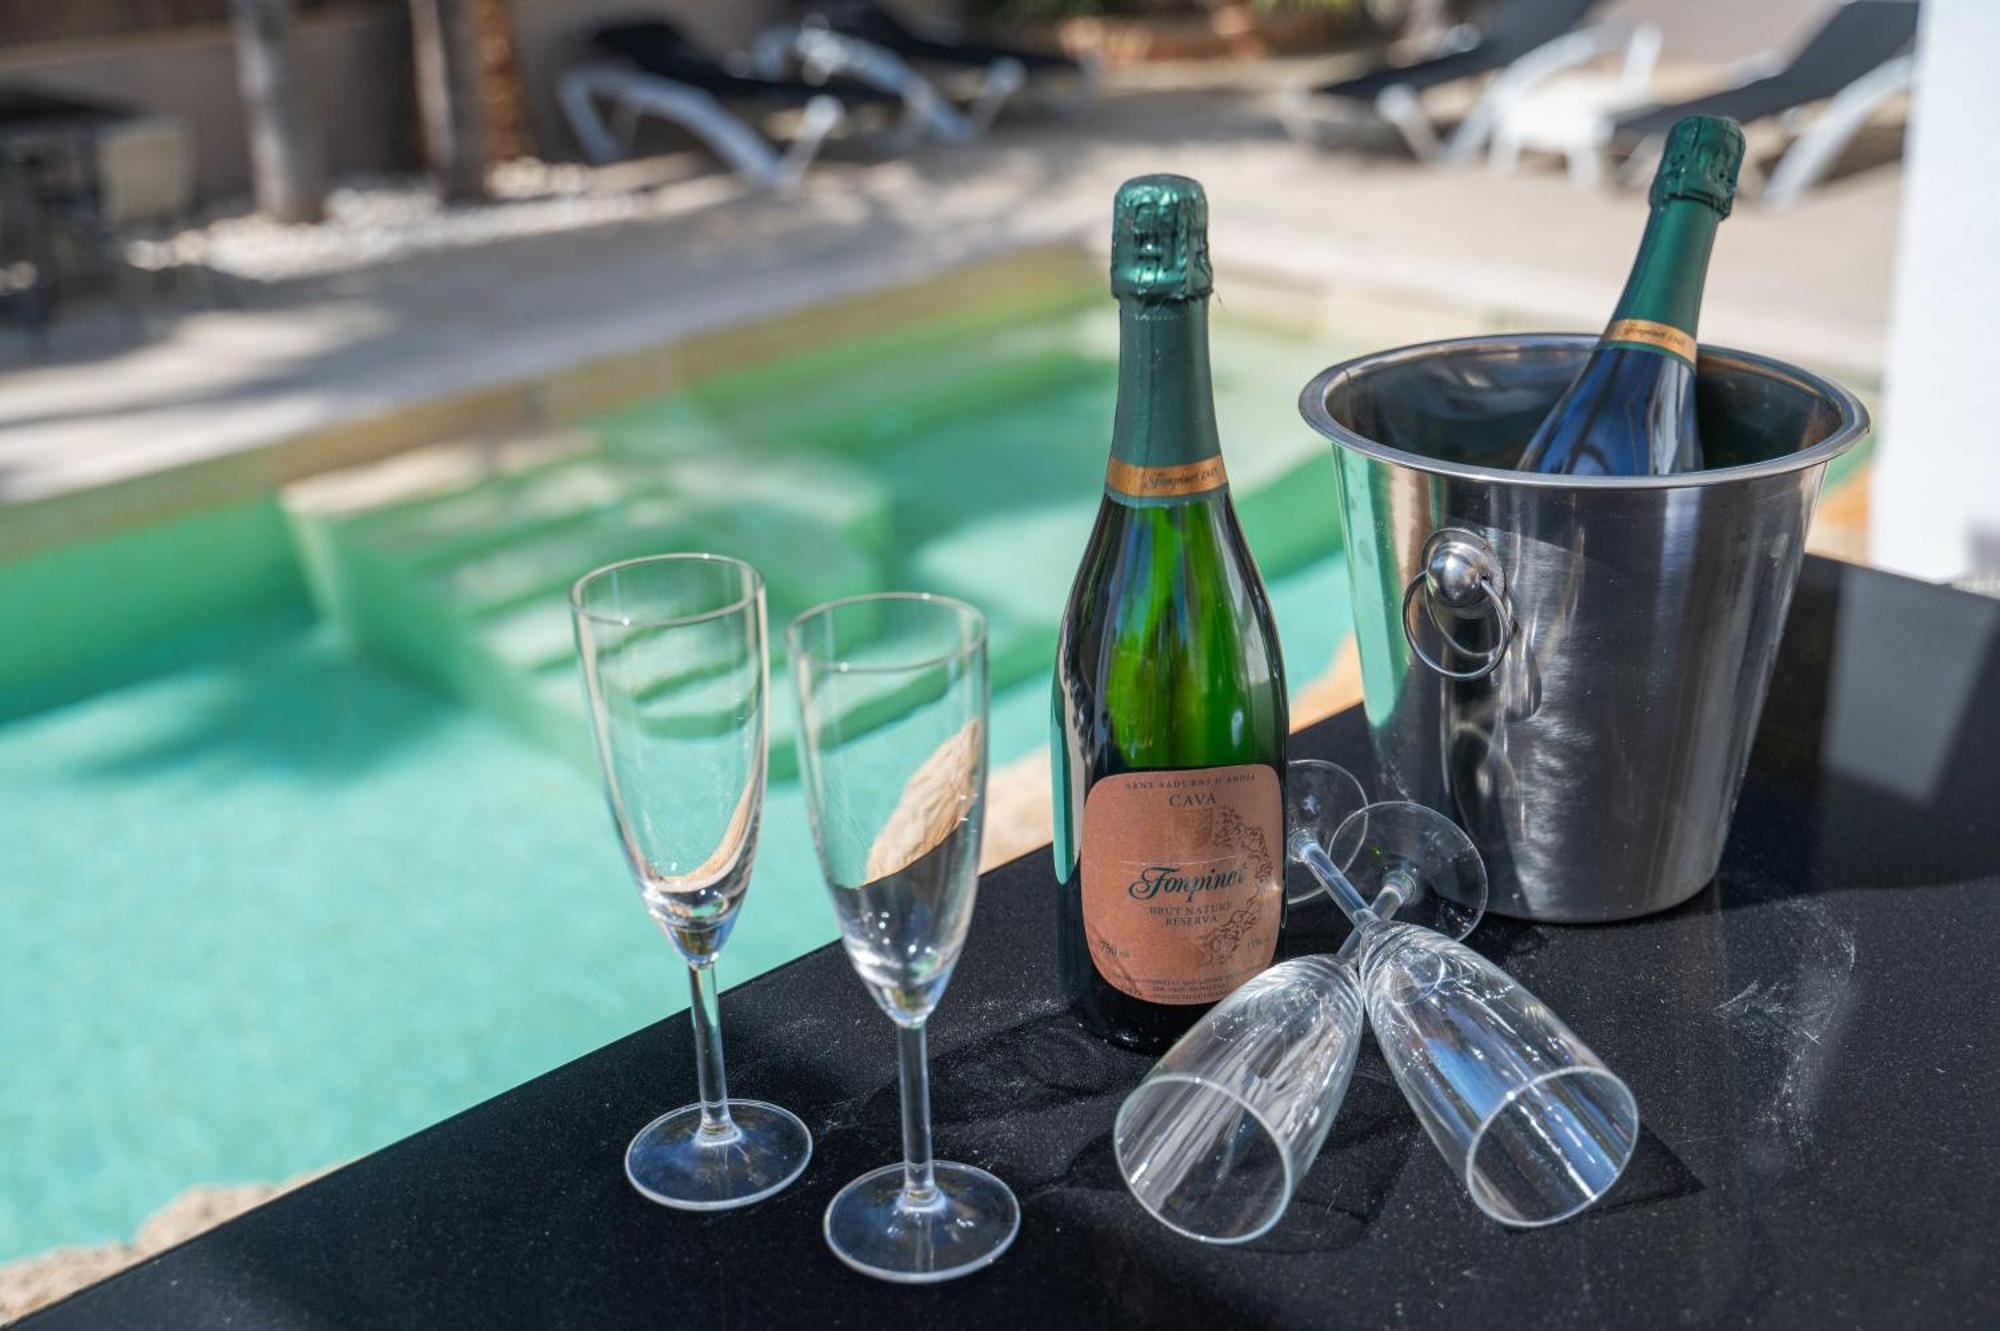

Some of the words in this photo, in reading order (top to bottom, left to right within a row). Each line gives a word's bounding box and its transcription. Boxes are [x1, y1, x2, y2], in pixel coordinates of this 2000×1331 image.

[1168, 791, 1217, 808] CAVA
[1149, 906, 1183, 915] BRUT
[1166, 914, 1218, 927] RESERVA
